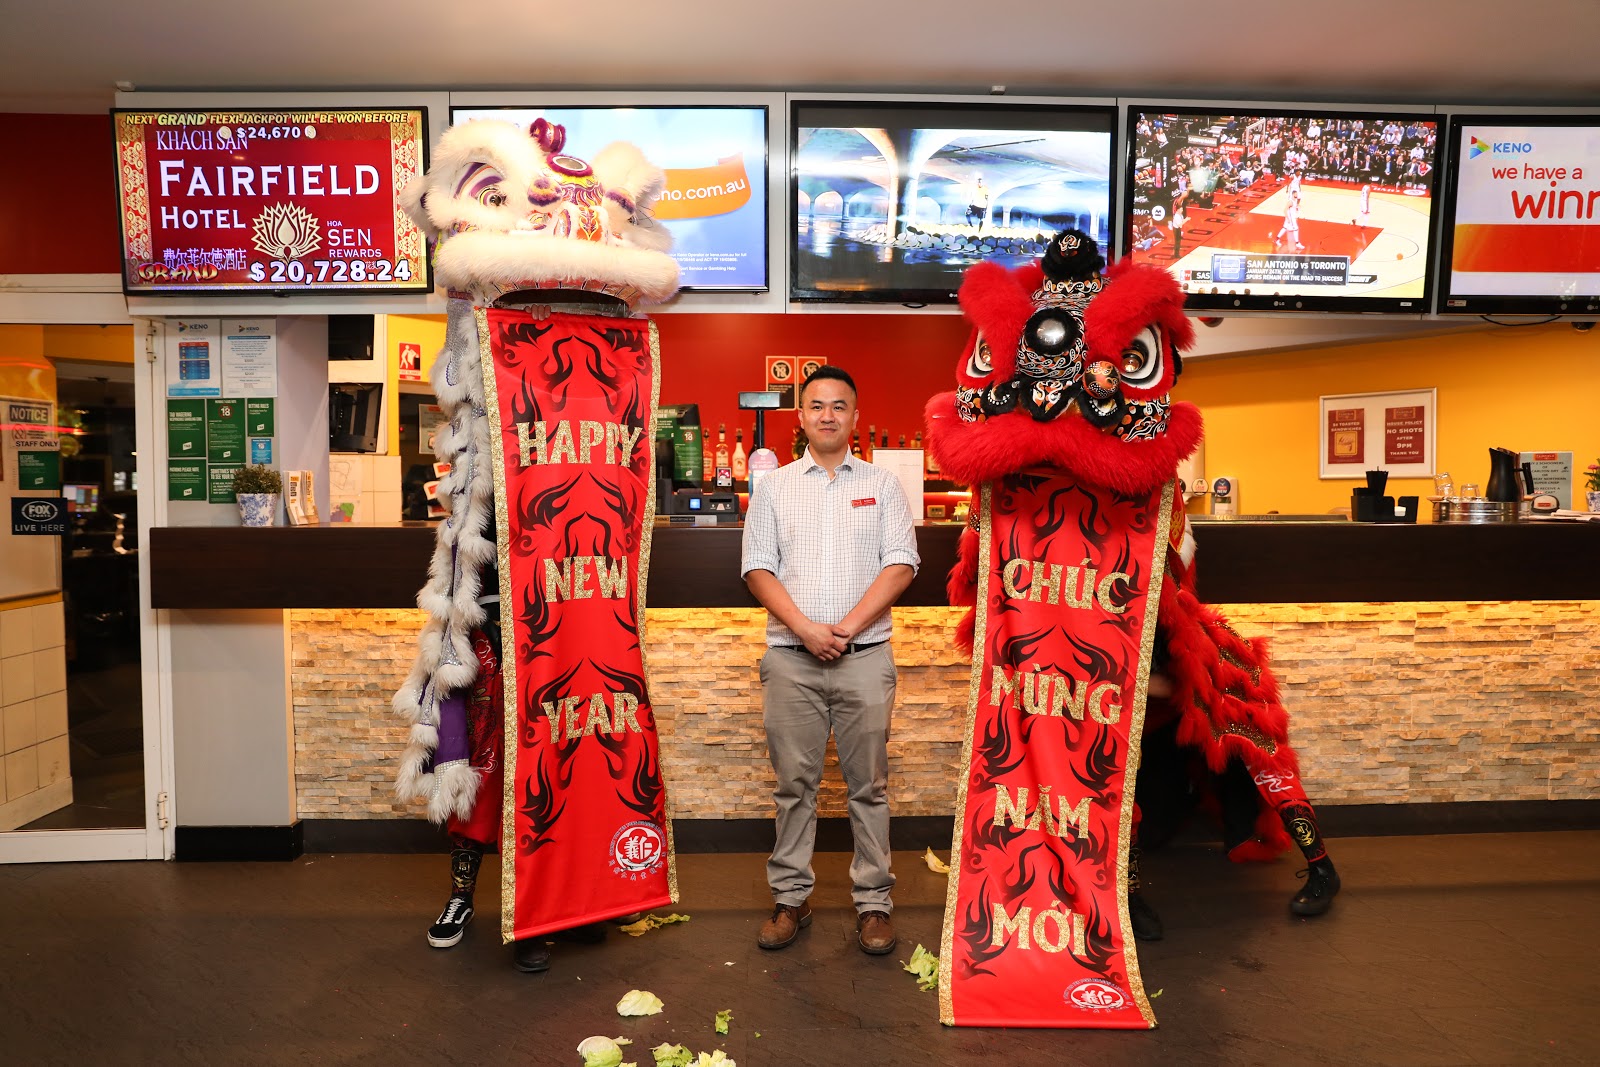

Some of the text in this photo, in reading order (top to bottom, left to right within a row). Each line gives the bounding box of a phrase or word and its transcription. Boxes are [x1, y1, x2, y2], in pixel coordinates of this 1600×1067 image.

[126, 113, 408, 126] NEXT GRAND FLEXI-JACKPOT WILL BE WON BEFORE
[156, 125, 213, 151] KHÁCH
[236, 126, 301, 139] $24,670
[1493, 142, 1532, 153] KENO
[158, 159, 380, 197] FAIRFIELD
[1491, 162, 1583, 180] we have a
[160, 206, 247, 229] HOTEL
[327, 220, 342, 228] HOA
[327, 228, 372, 247] SEN
[329, 249, 382, 258] REWARDS
[138, 262, 218, 282] GRAND
[1247, 260, 1263, 268] SAN
[1263, 260, 1299, 269] ANTONIO
[1310, 261, 1346, 270] TORONTO
[11, 407, 47, 422] NOTICE
[220, 407, 231, 417] 18
[516, 419, 644, 468] HAPPY
[28, 505, 51, 515] FOX
[14, 524, 65, 532] LIVE HERE
[543, 555, 628, 603] NEW
[1002, 557, 1131, 615] CHÚC
[989, 663, 1122, 725] MỪNG
[541, 691, 643, 745] YEAR
[992, 783, 1093, 839] NĂM
[990, 900, 1087, 957] MỚI
